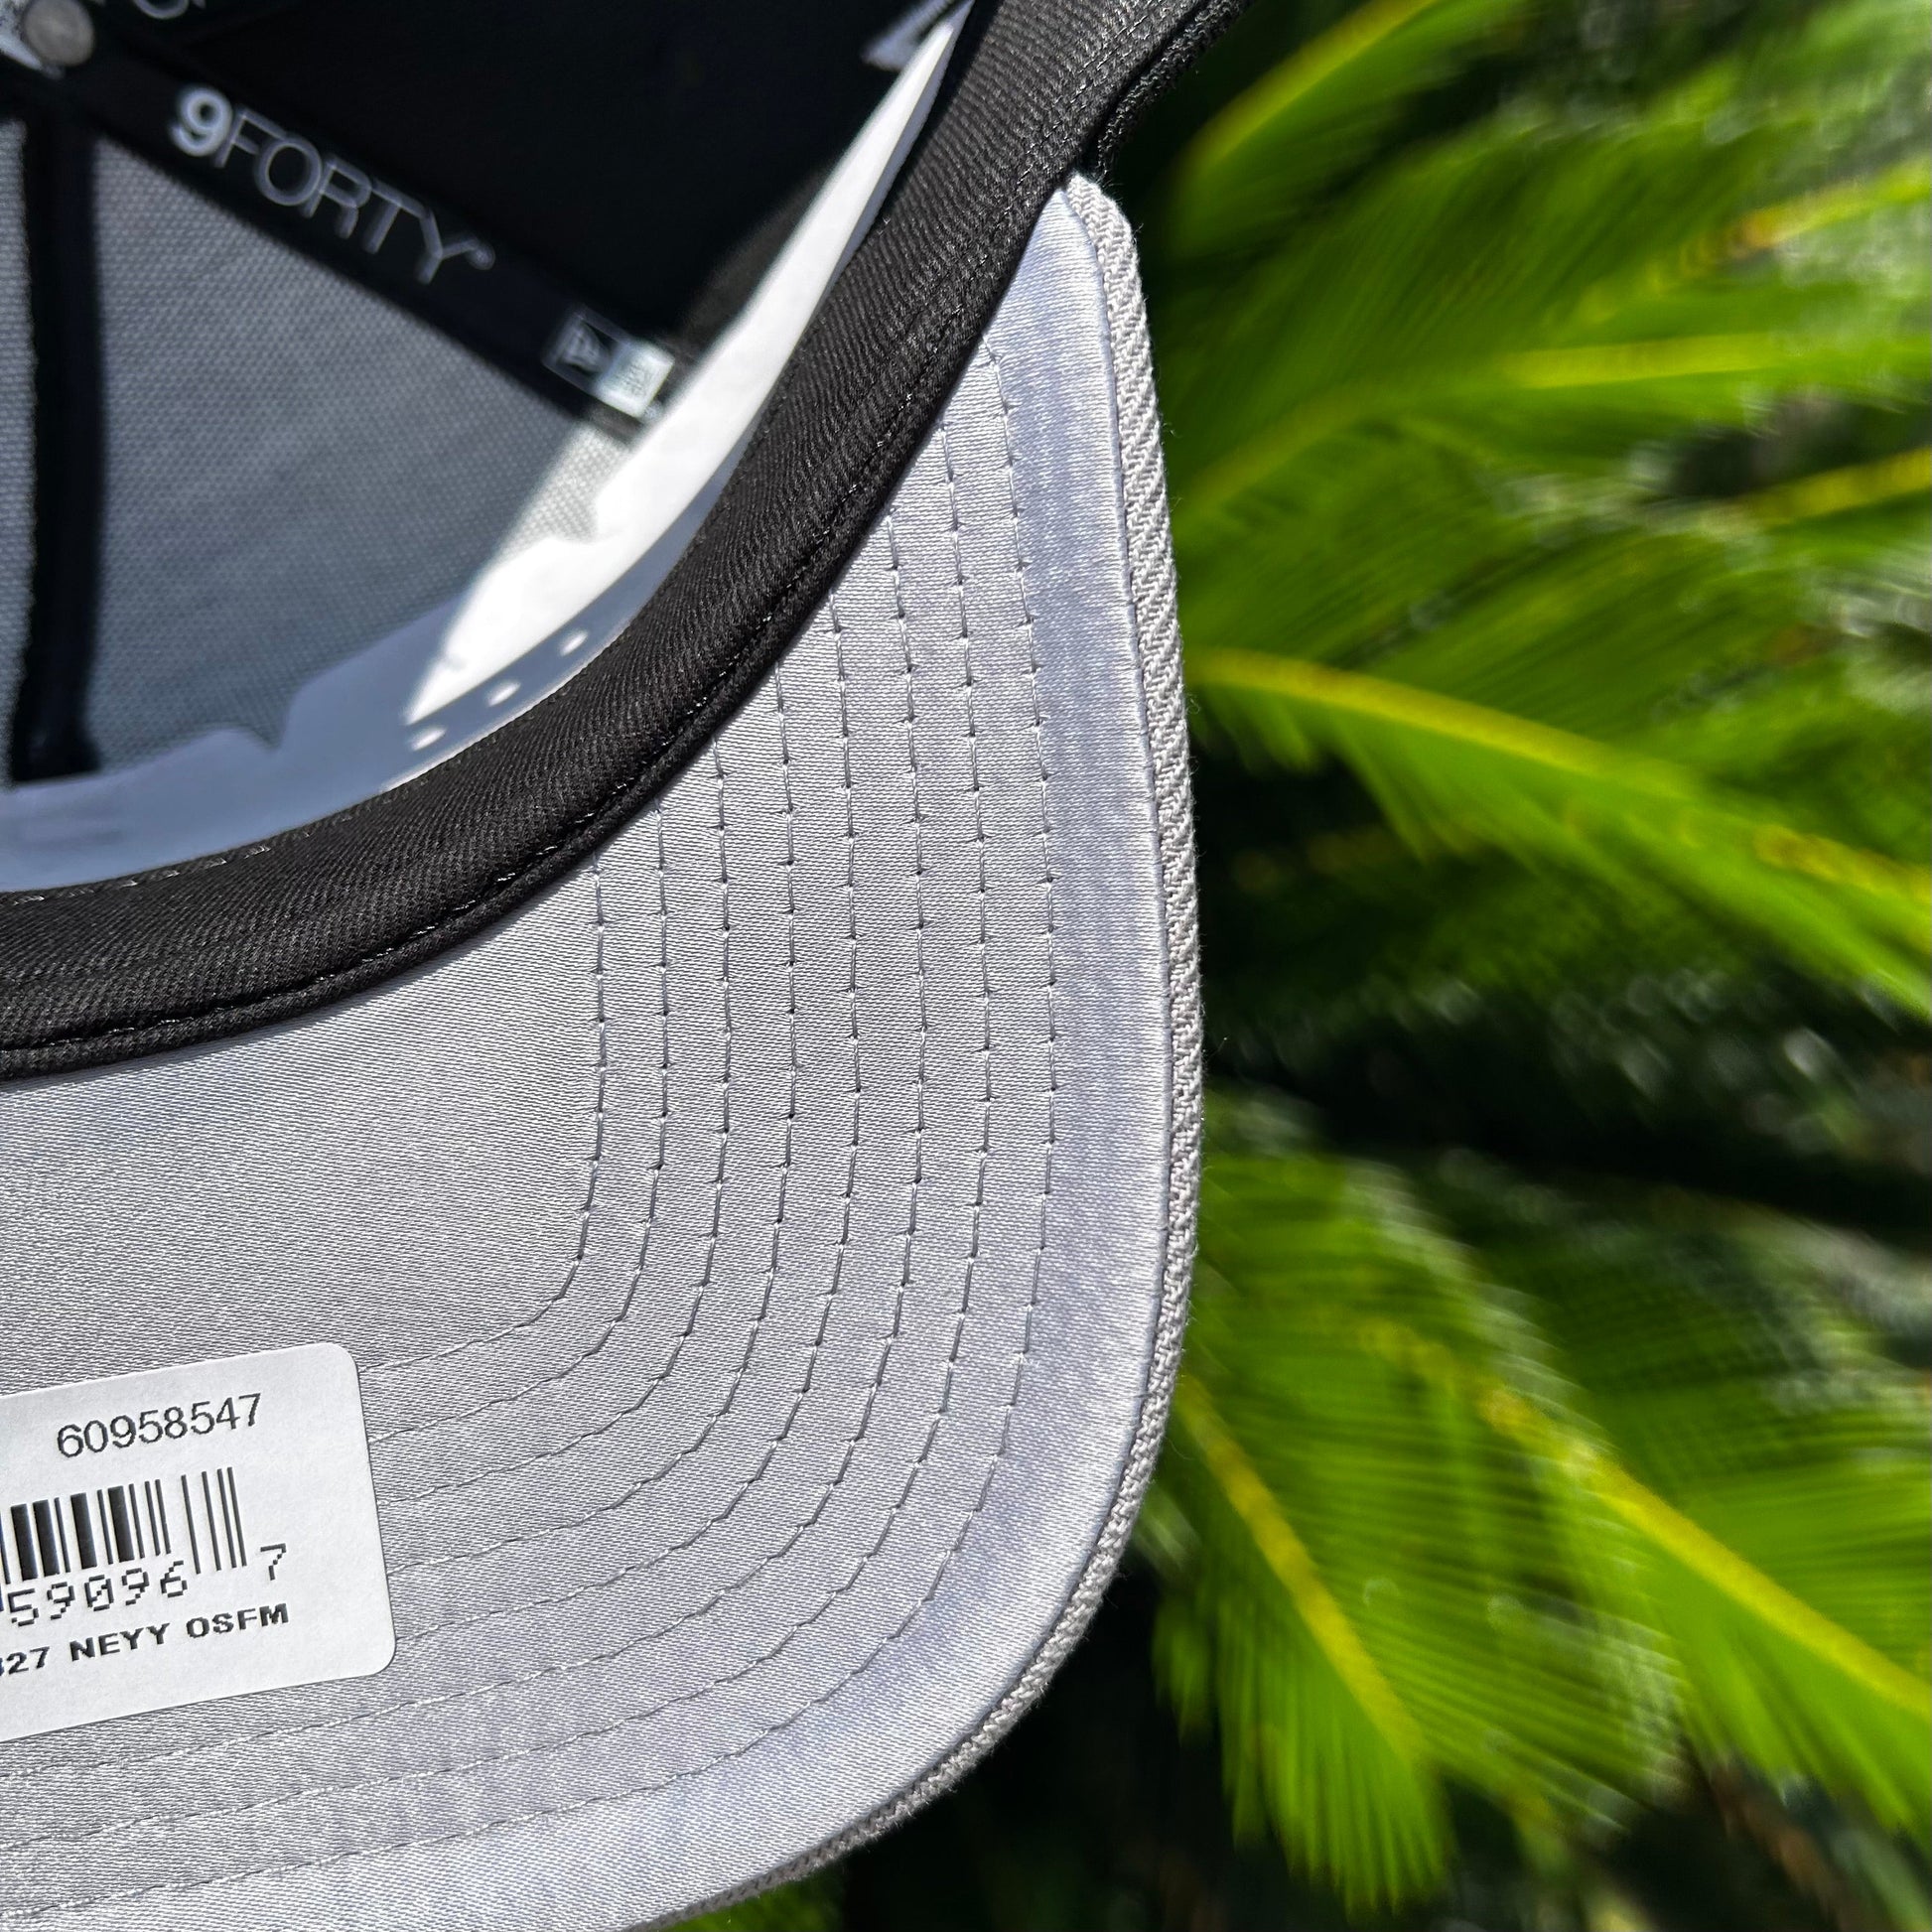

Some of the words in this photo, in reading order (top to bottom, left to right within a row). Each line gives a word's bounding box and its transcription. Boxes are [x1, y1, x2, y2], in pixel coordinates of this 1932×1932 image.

[57, 1393, 261, 1457] 60958547
[0, 1560, 189, 1627] 59096
[260, 1543, 287, 1582] 7
[0, 1646, 50, 1677] 27
[69, 1622, 170, 1661] NEYY
[186, 1603, 289, 1638] OSFM
